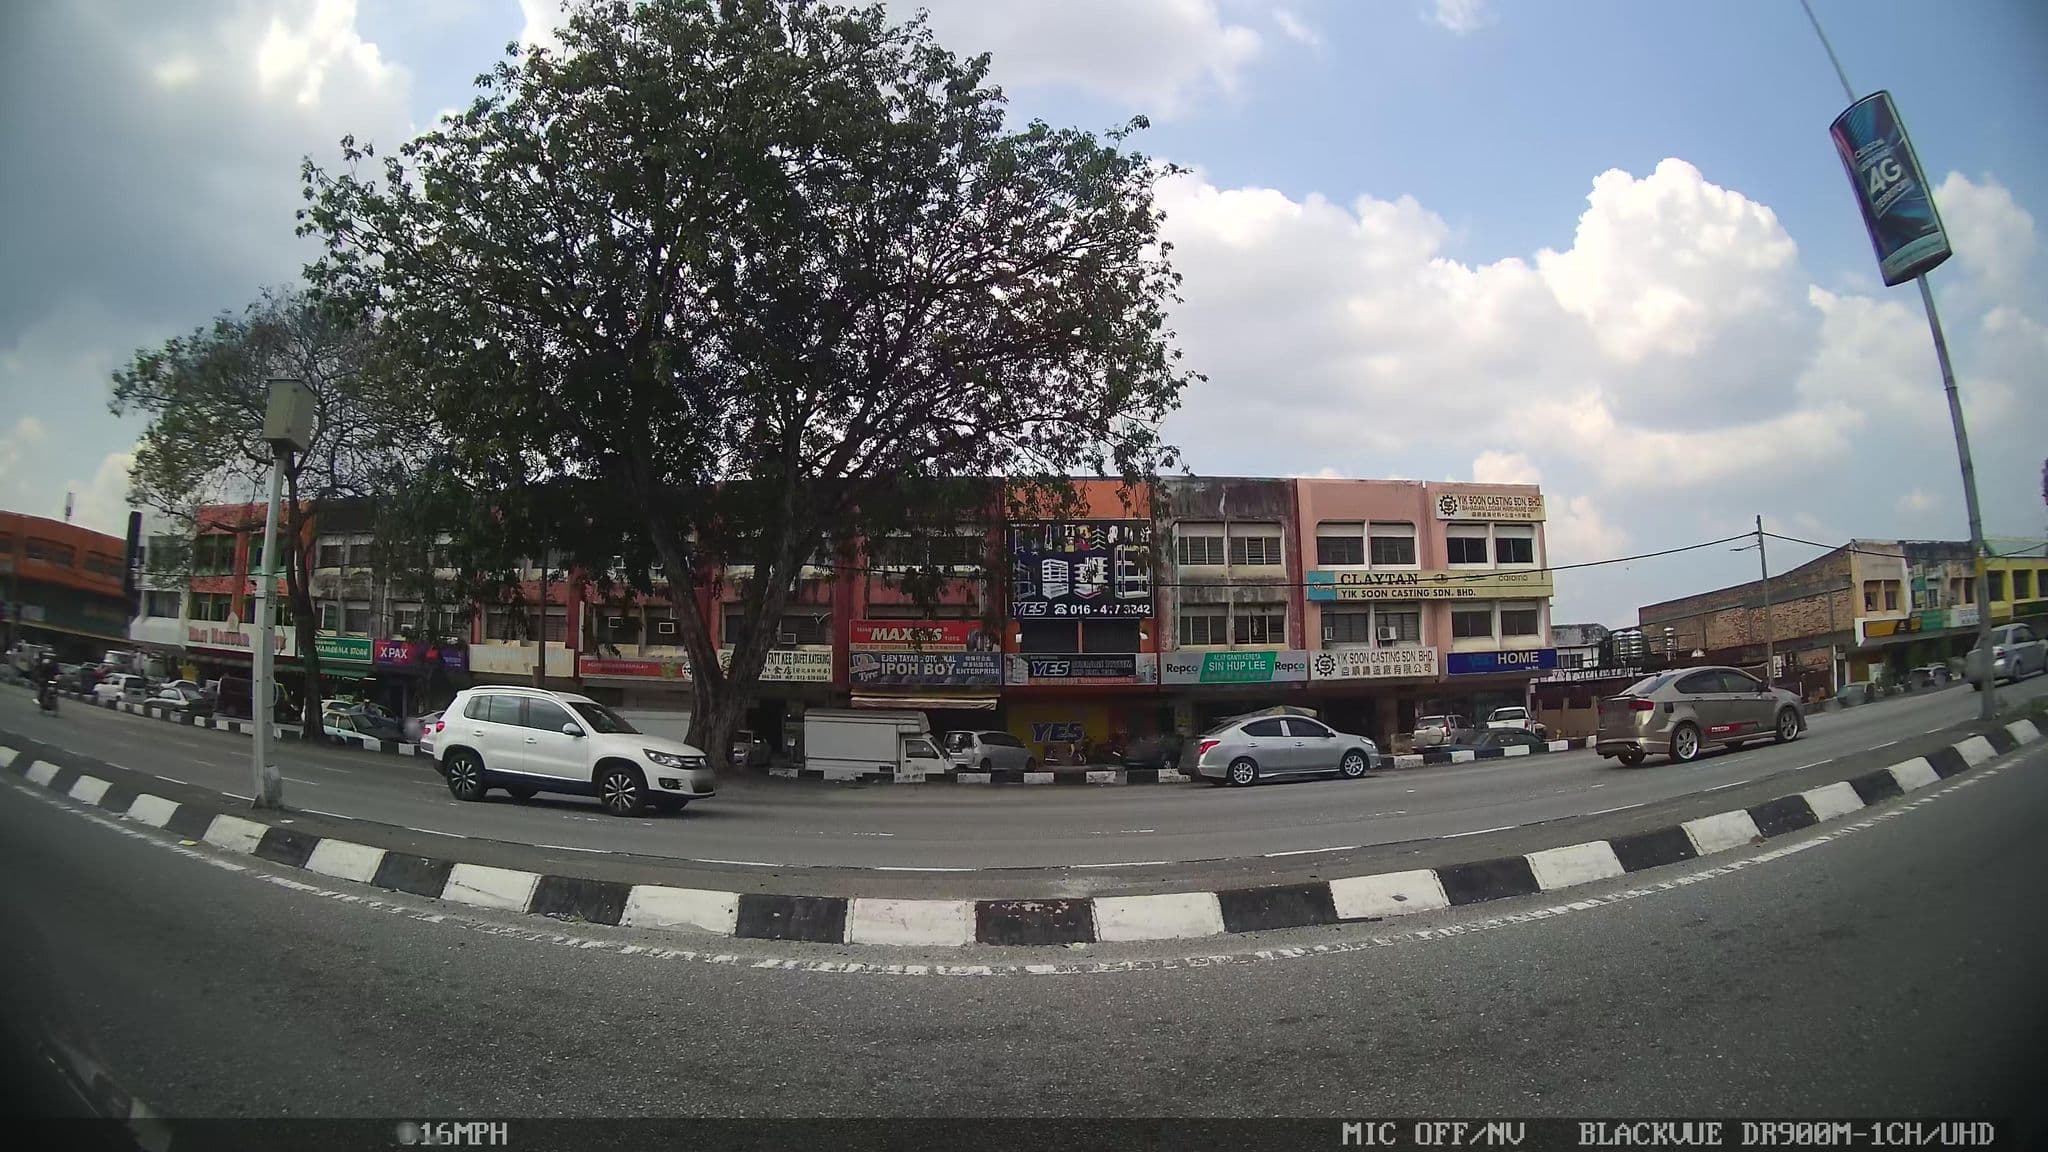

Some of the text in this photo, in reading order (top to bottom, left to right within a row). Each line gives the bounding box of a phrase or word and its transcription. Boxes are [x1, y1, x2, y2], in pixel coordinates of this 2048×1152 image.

[1870, 158, 1902, 194] 4G
[1340, 573, 1419, 586] CLAYTAN
[1341, 589, 1357, 598] YIK
[1361, 589, 1388, 598] SOON
[1392, 589, 1429, 597] CASTING
[1433, 589, 1454, 597] SDN.
[1012, 601, 1048, 616] YES
[1070, 604, 1090, 614] 016
[1350, 652, 1369, 664] SOON
[1371, 651, 1400, 663] CASTING
[1498, 652, 1539, 665] HOME
[882, 663, 919, 675] IPOH
[924, 663, 956, 675] BOY
[1032, 660, 1070, 676] YES
[1167, 663, 1198, 674] Repco
[1209, 661, 1266, 671] SIN HUP LEE
[1275, 661, 1305, 672] Repco
[1031, 721, 1084, 743] YES
